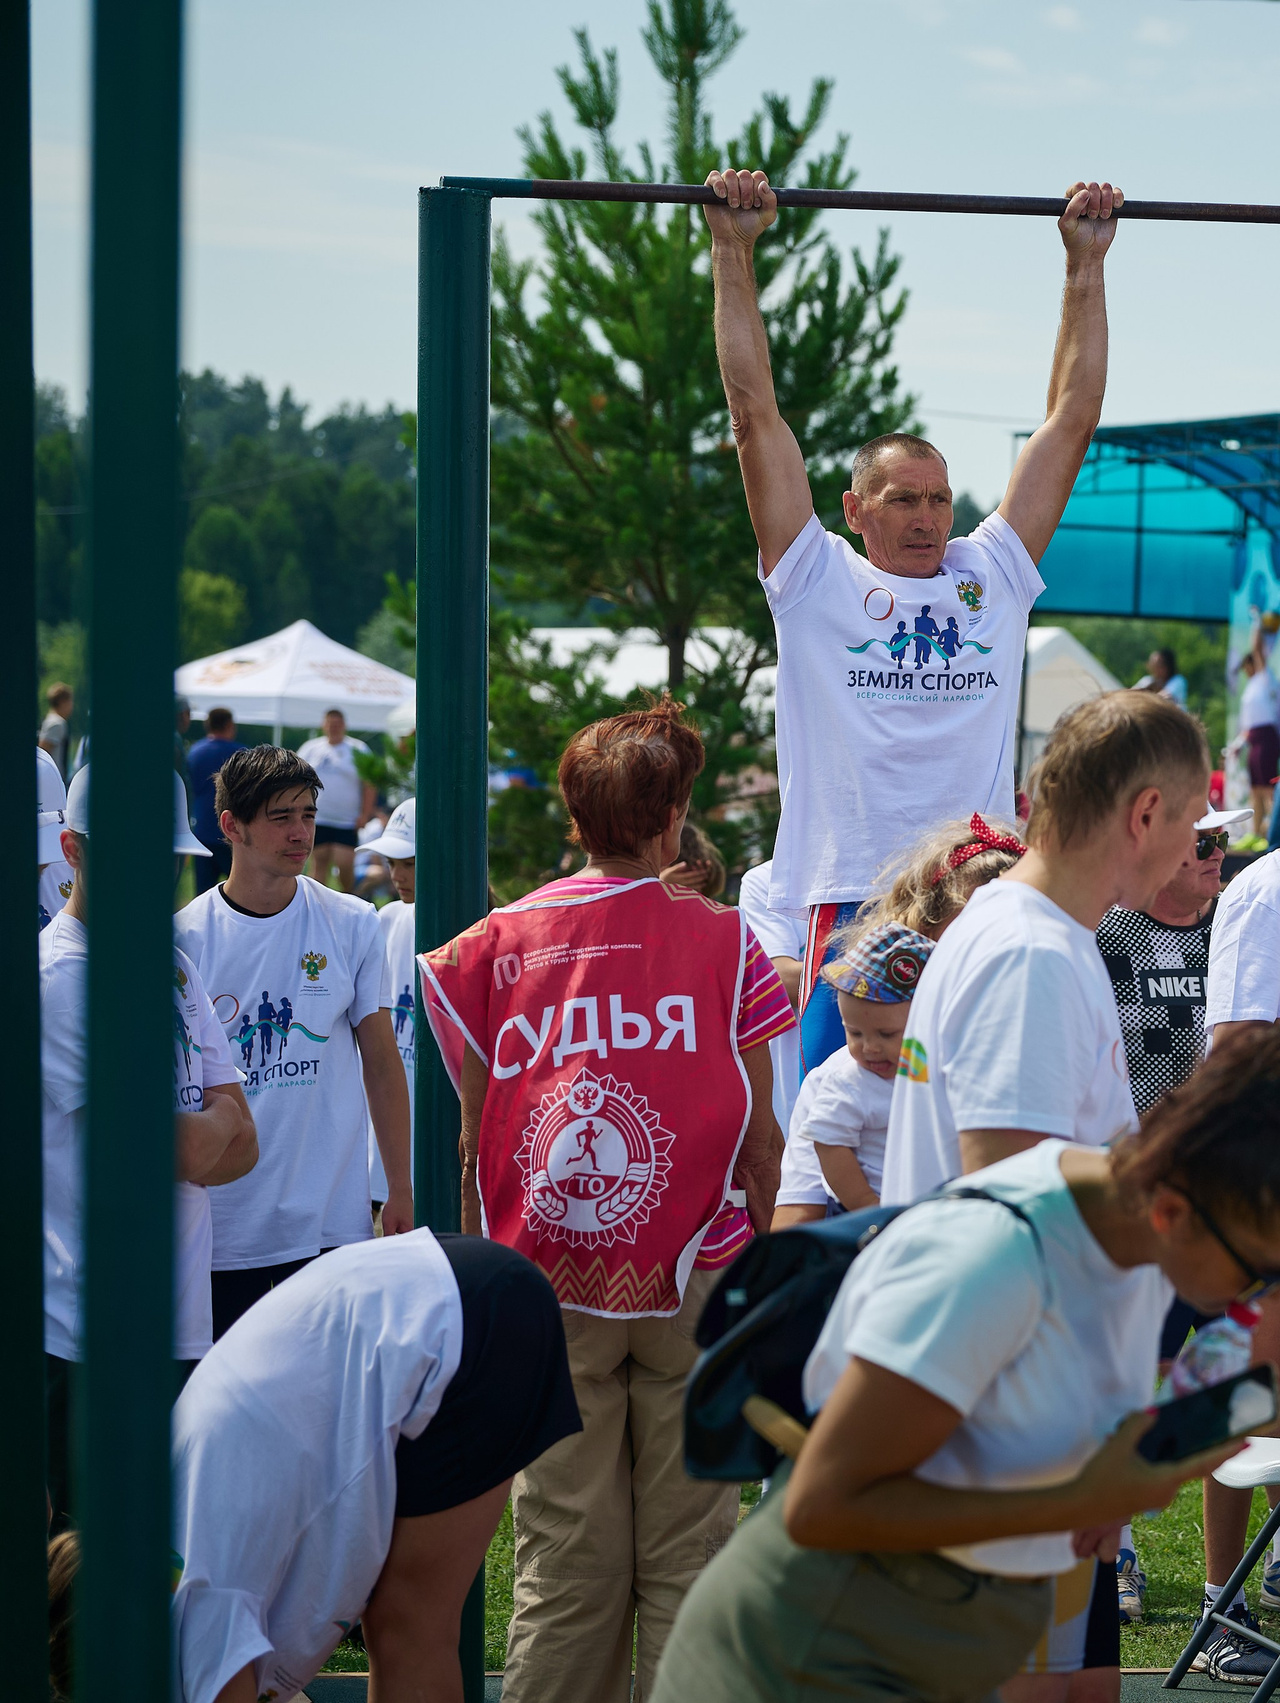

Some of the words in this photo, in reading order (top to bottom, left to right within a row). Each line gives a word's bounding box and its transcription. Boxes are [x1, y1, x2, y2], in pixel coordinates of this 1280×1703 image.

[847, 670, 914, 690] ЗЕМЛЯ
[921, 671, 999, 691] СПОРТА
[856, 691, 939, 703] ВСЕРОССИЙСКИЙ
[942, 693, 985, 703] МАРАФОН
[1147, 976, 1202, 998] NIKE
[492, 994, 697, 1080] СУДЬЯ
